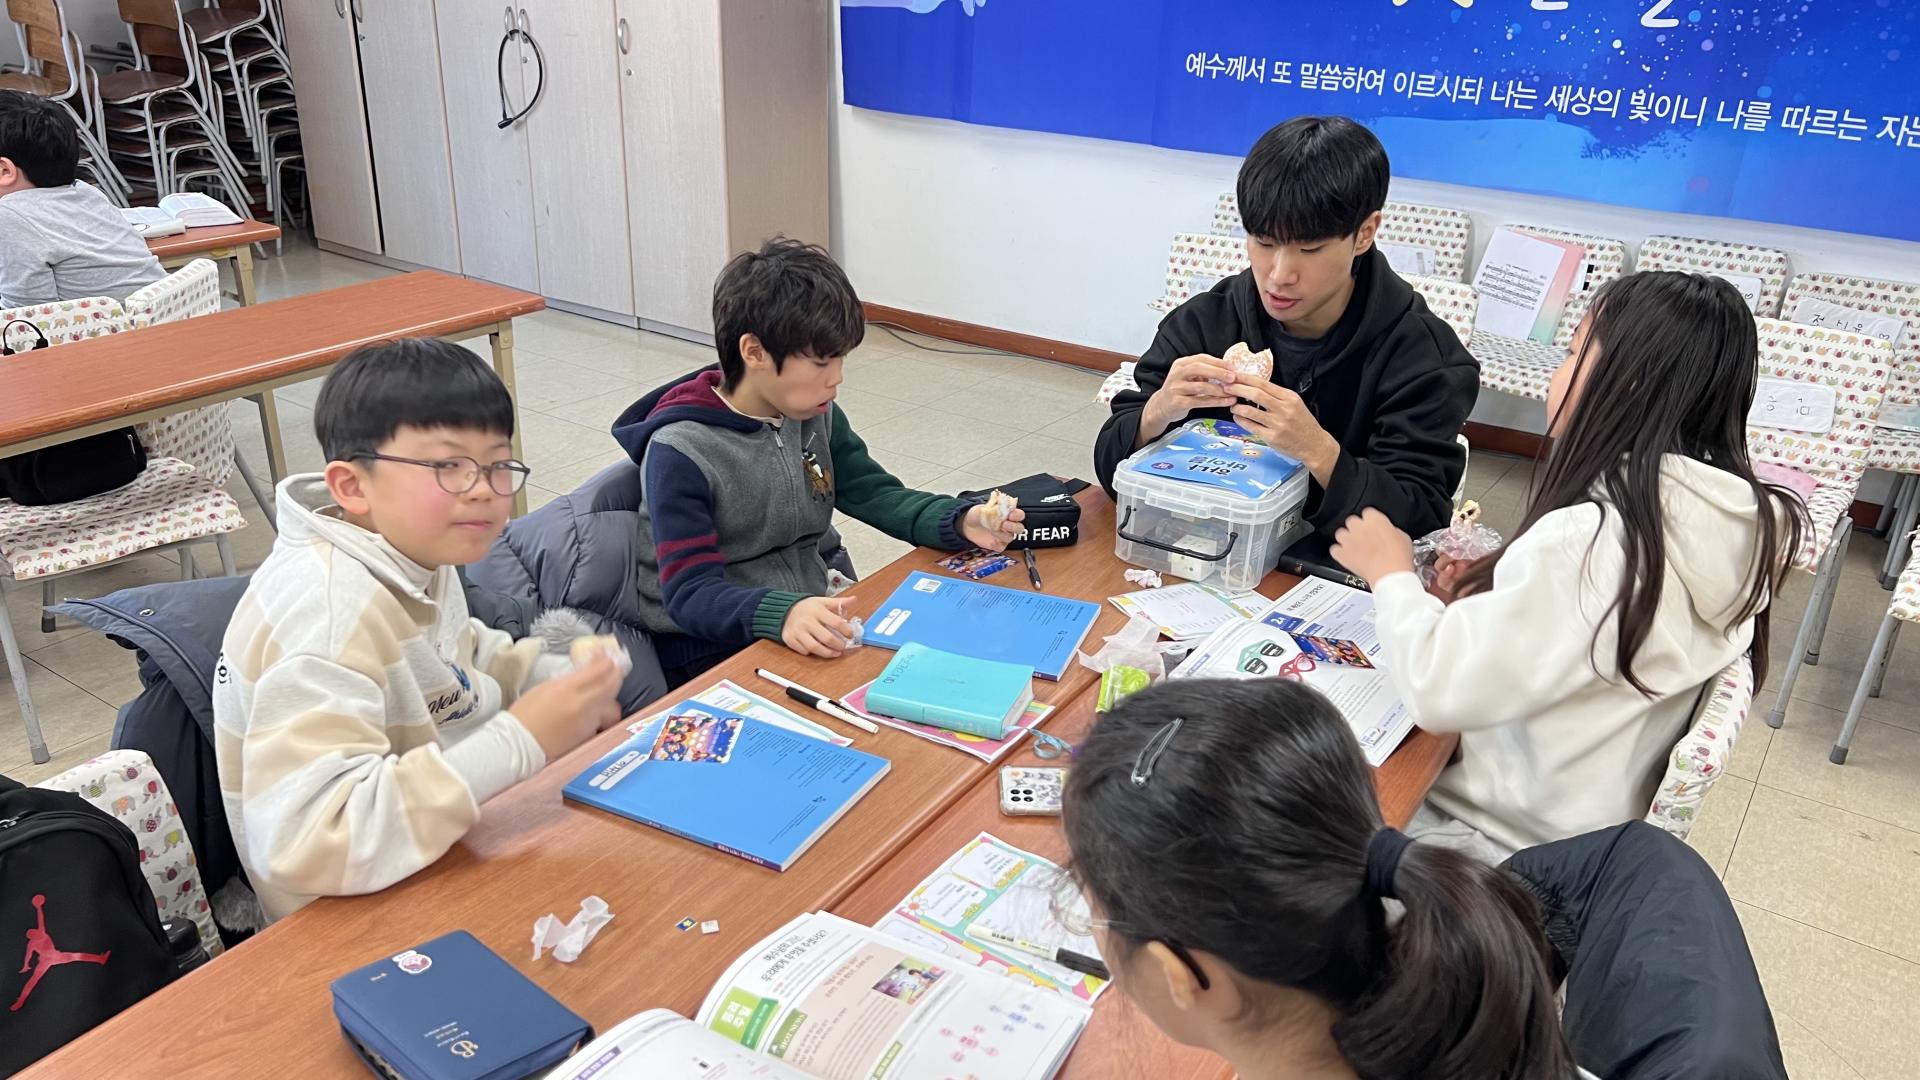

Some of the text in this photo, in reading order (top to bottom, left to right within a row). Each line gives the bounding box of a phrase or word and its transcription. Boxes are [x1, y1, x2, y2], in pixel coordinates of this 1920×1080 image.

[1185, 52, 1266, 84] 예수께서
[1270, 61, 1293, 84] 또
[1300, 63, 1386, 96] 말씀하여
[1393, 71, 1483, 105] 이르시되
[1490, 79, 1538, 110] 나는
[1544, 84, 1622, 118] 세상의
[1628, 90, 1708, 127] 빛이니
[1716, 99, 1772, 132] 나를
[1781, 105, 1868, 142] 따르는
[1188, 464, 1231, 476] 하나
[1012, 526, 1070, 541] R FEAR
